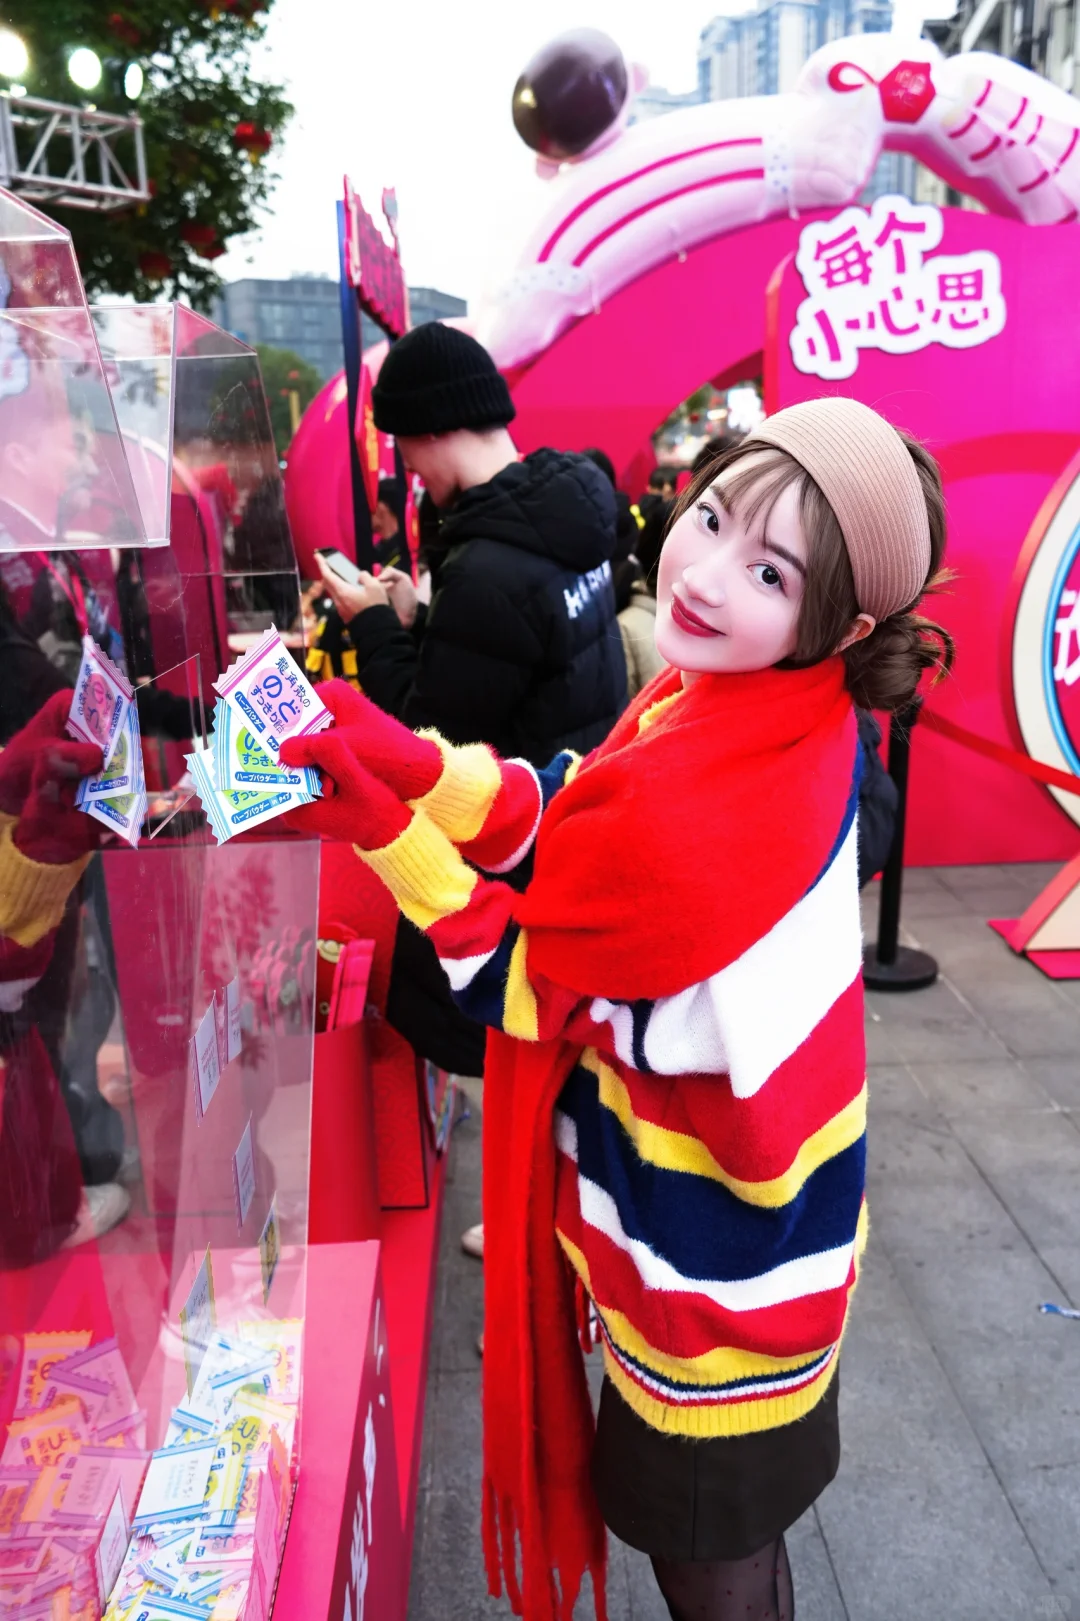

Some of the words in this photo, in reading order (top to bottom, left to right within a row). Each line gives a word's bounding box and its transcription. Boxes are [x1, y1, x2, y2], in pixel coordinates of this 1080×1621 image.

[814, 211, 926, 288] 每个
[806, 268, 990, 362] 小心思
[250, 684, 285, 734] すっきり飴
[262, 674, 301, 724] のど
[236, 772, 277, 783] ハーブパウダー
[233, 802, 270, 824] ハーブパウダー
